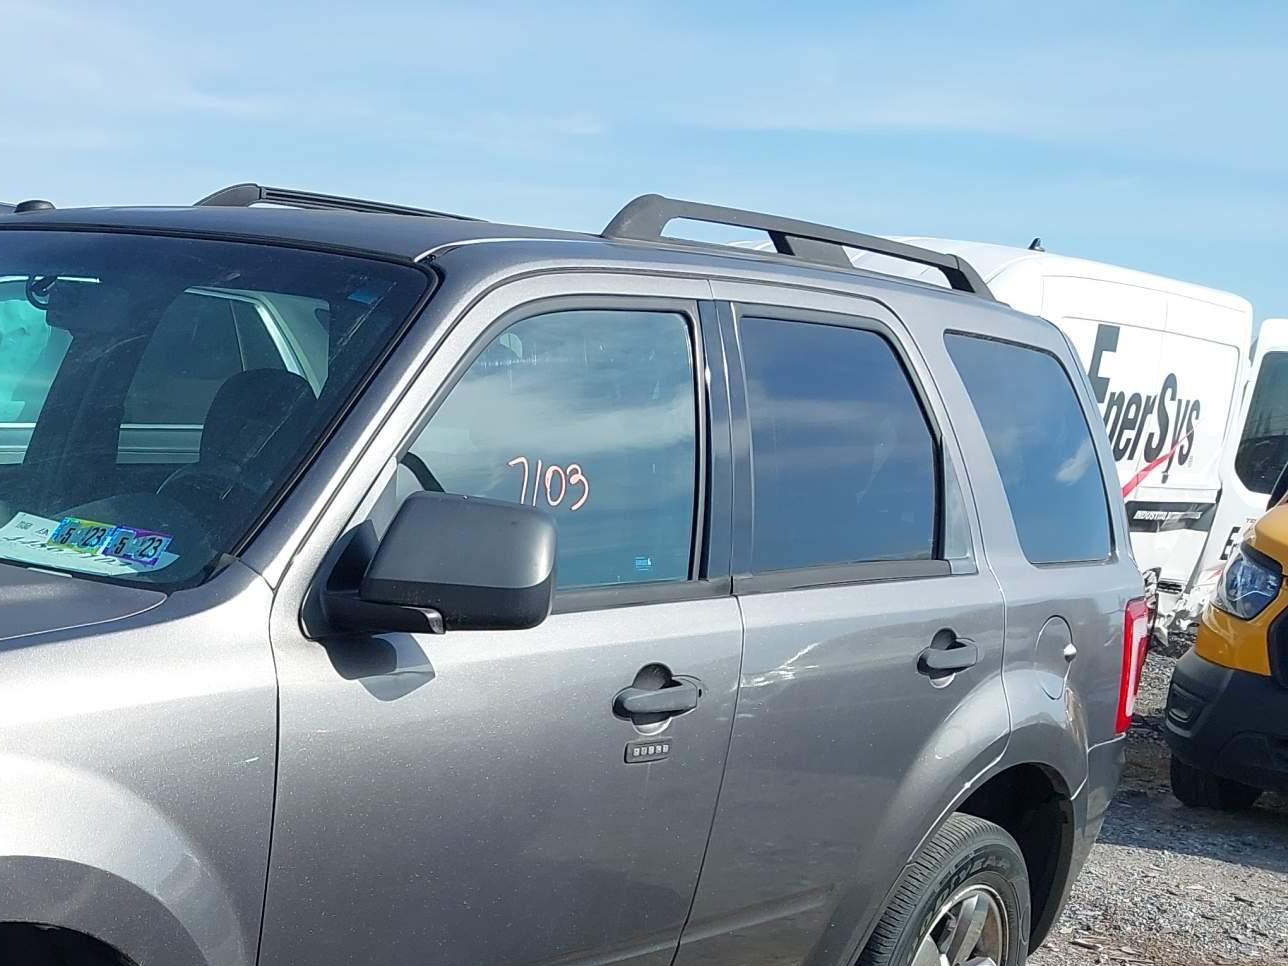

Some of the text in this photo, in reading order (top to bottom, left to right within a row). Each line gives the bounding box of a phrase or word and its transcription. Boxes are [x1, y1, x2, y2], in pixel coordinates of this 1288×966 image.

[1087, 323, 1201, 484] EnerSys
[507, 456, 590, 511] 7103
[60, 527, 76, 544] 5
[114, 537, 129, 554] 5
